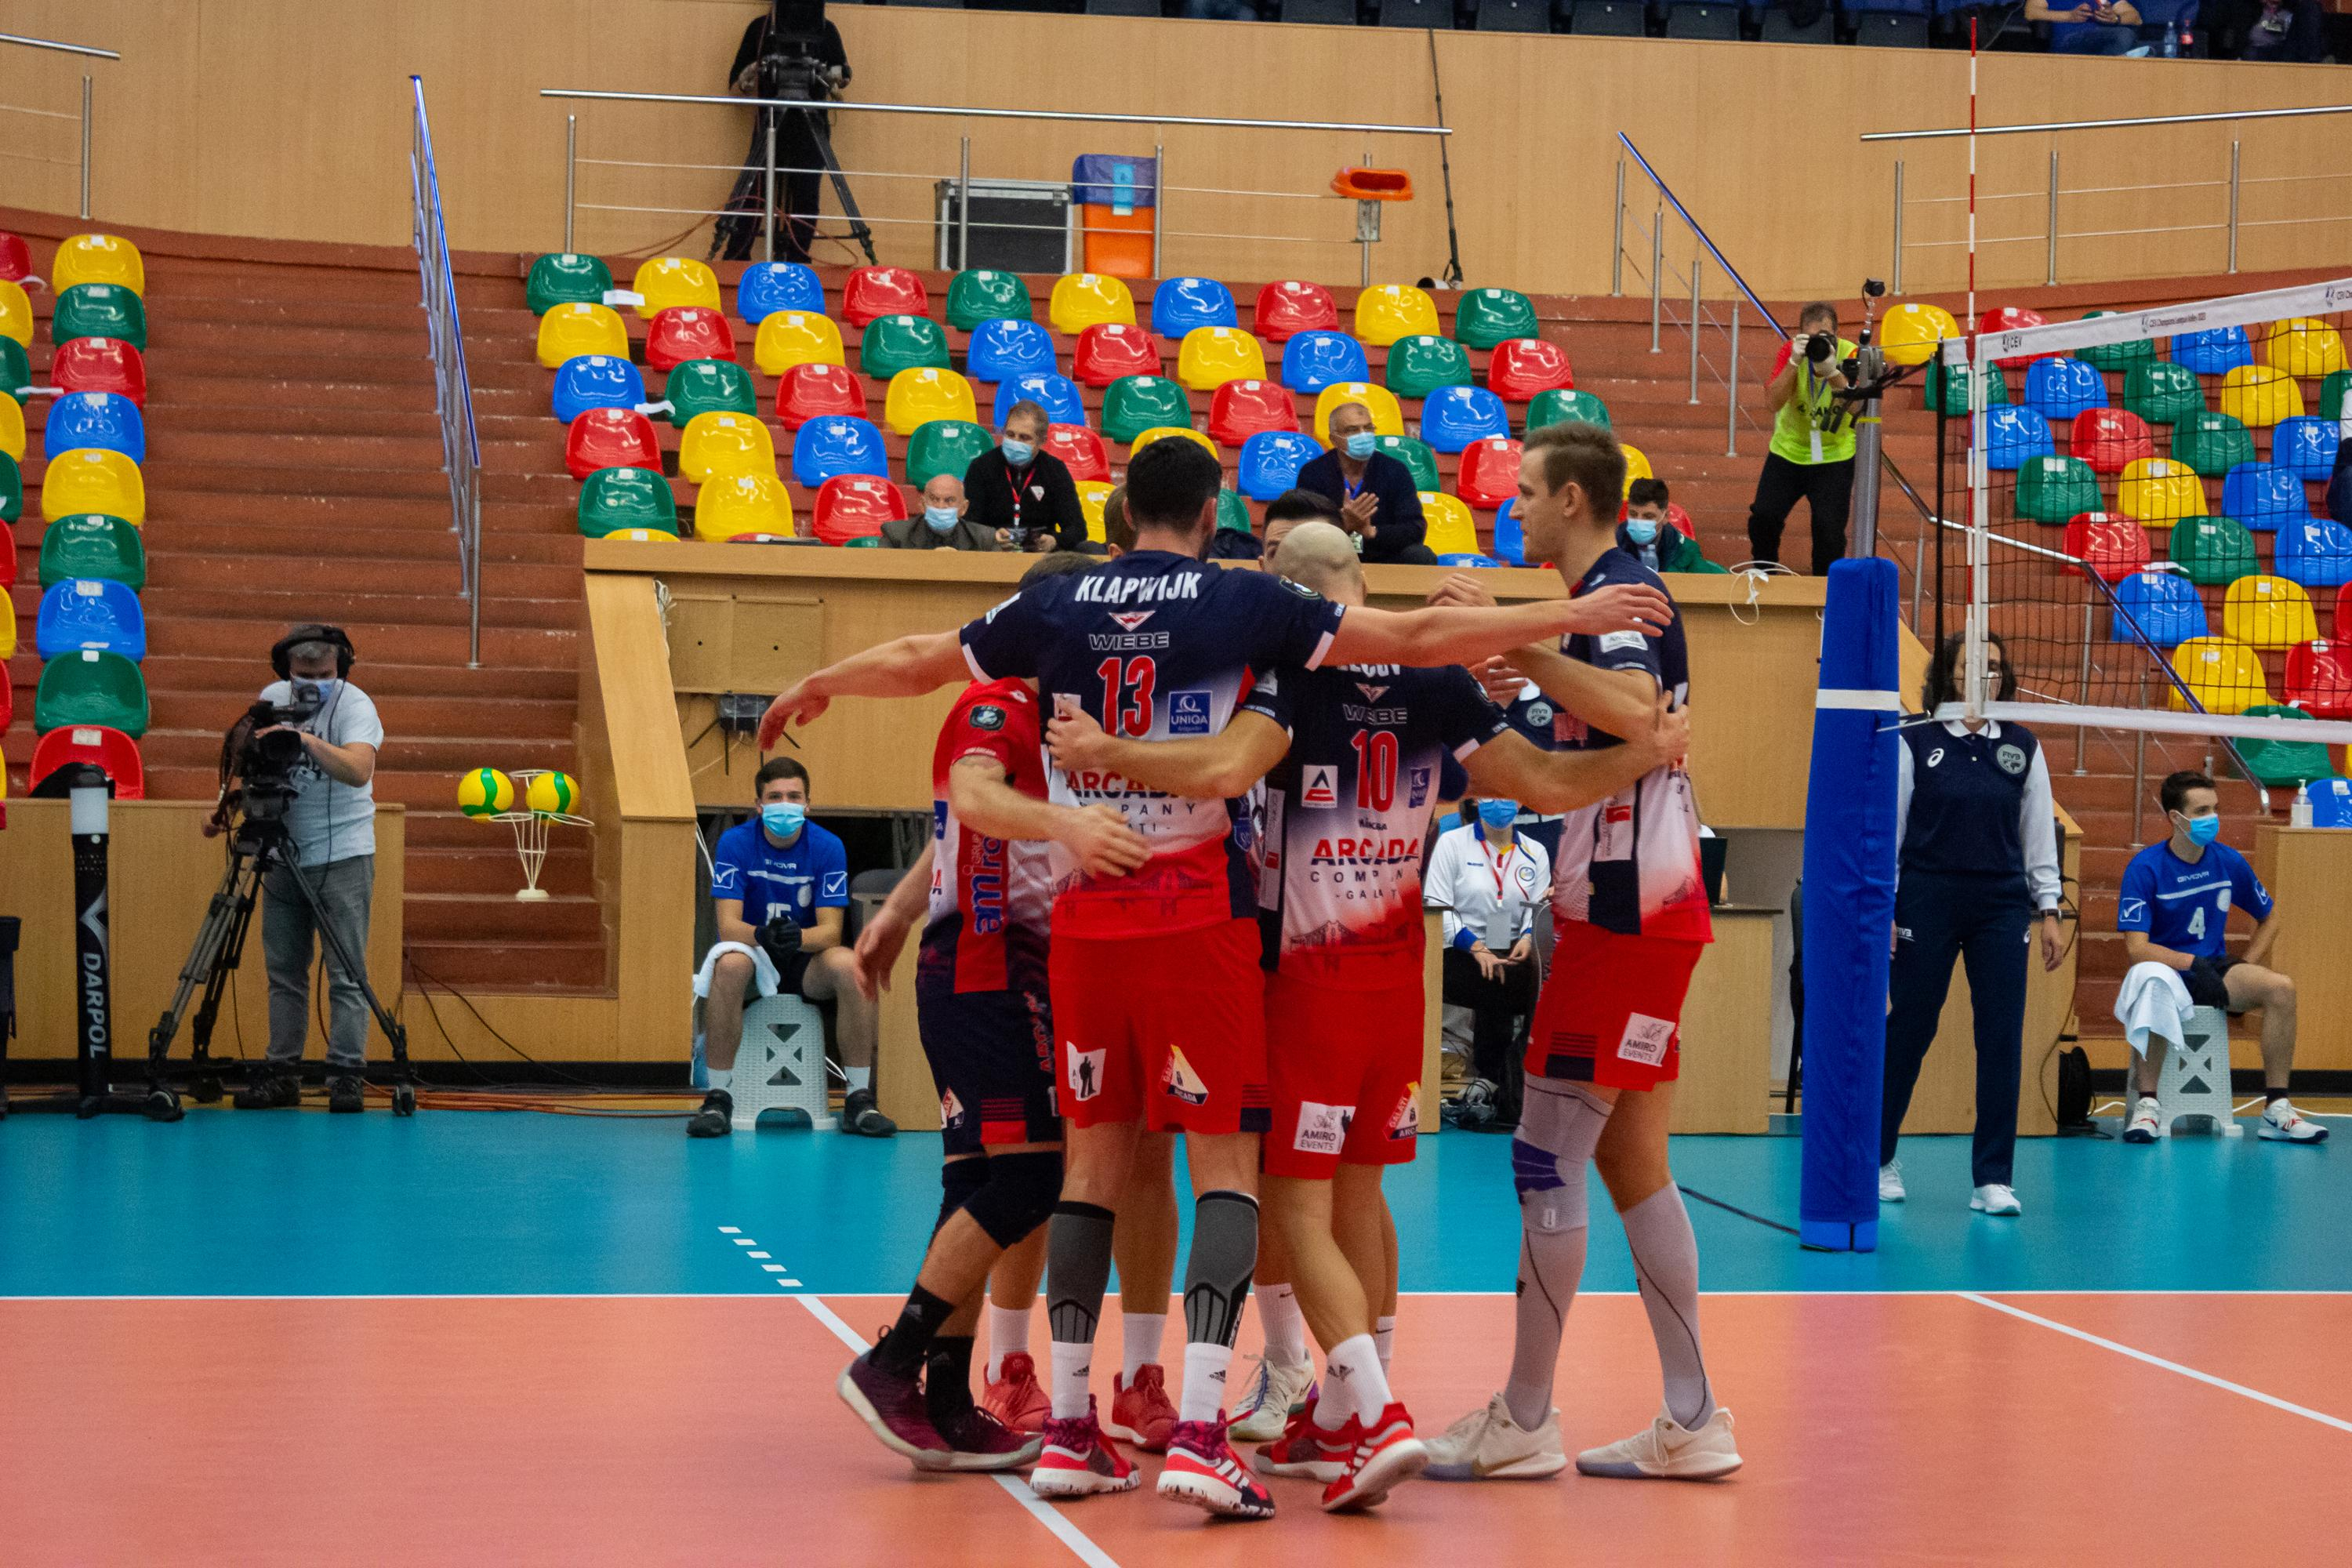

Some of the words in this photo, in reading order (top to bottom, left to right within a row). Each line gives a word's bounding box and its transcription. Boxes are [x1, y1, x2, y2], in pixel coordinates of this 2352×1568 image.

[2010, 336, 2022, 348] CEV
[1074, 572, 1203, 604] KLAPWIJK
[1088, 631, 1170, 651] WIEBE
[1097, 655, 1156, 738] 13
[1171, 714, 1209, 725] UNIQA
[2002, 750, 2021, 760] FIVB
[1350, 728, 1399, 813] 10
[2177, 870, 2210, 884] GIVOVA
[2187, 906, 2206, 940] 4
[83, 953, 107, 1059] DARPOL
[1624, 1039, 1657, 1053] AMIRO
[1302, 1129, 1337, 1141] AMIRO
[1300, 1138, 1333, 1152] EVENTS
